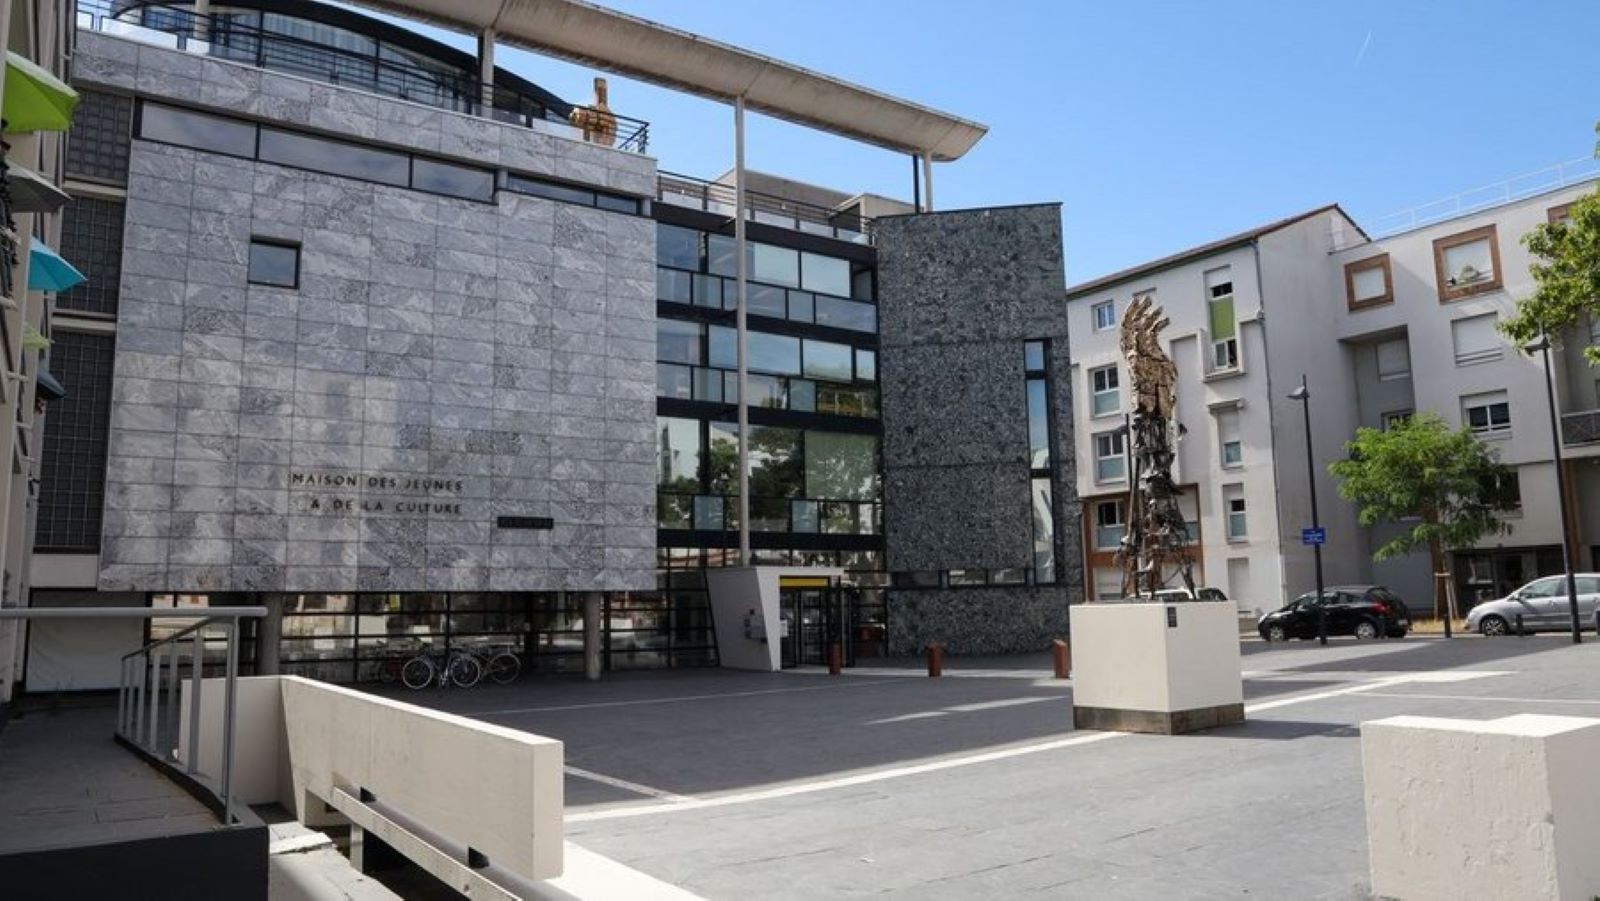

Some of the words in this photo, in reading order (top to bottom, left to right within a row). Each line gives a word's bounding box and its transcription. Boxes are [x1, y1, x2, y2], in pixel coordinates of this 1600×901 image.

[292, 473, 357, 487] MAISON
[368, 476, 397, 489] DES
[404, 479, 464, 491] JEUNES
[333, 499, 353, 511] DE
[364, 501, 383, 512] LA
[395, 502, 461, 514] CULTURE
